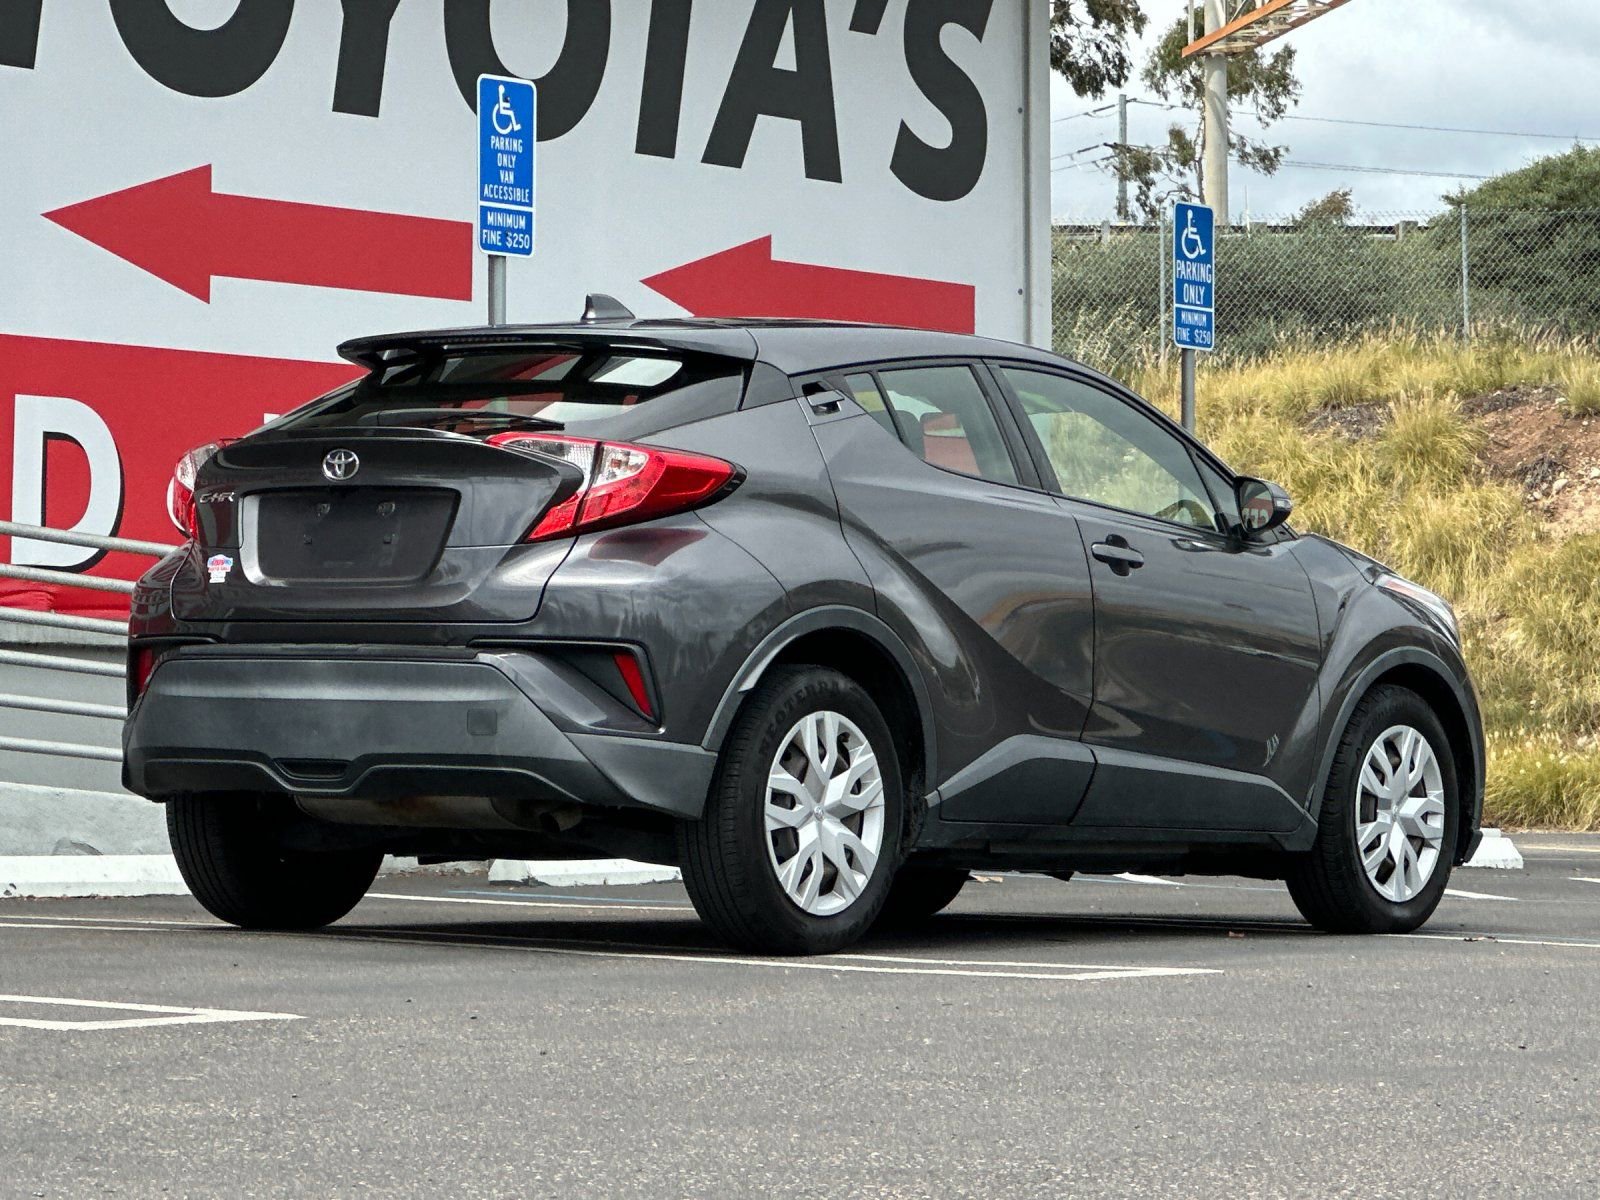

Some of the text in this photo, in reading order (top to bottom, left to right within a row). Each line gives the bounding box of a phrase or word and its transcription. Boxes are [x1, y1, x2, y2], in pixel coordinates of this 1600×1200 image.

[0, 0, 993, 202] YOA'S
[490, 135, 523, 153] PARKING
[497, 153, 517, 169] ONLY
[499, 170, 514, 185] VAN
[483, 184, 530, 203] ACCESSIBLE
[487, 211, 526, 230] MINIMUM
[482, 229, 531, 249] FINE $250
[1176, 260, 1212, 284] PARKING
[1183, 283, 1206, 305] ONLY
[1181, 310, 1207, 327] MINIMUM
[1177, 327, 1211, 345] FINE $250
